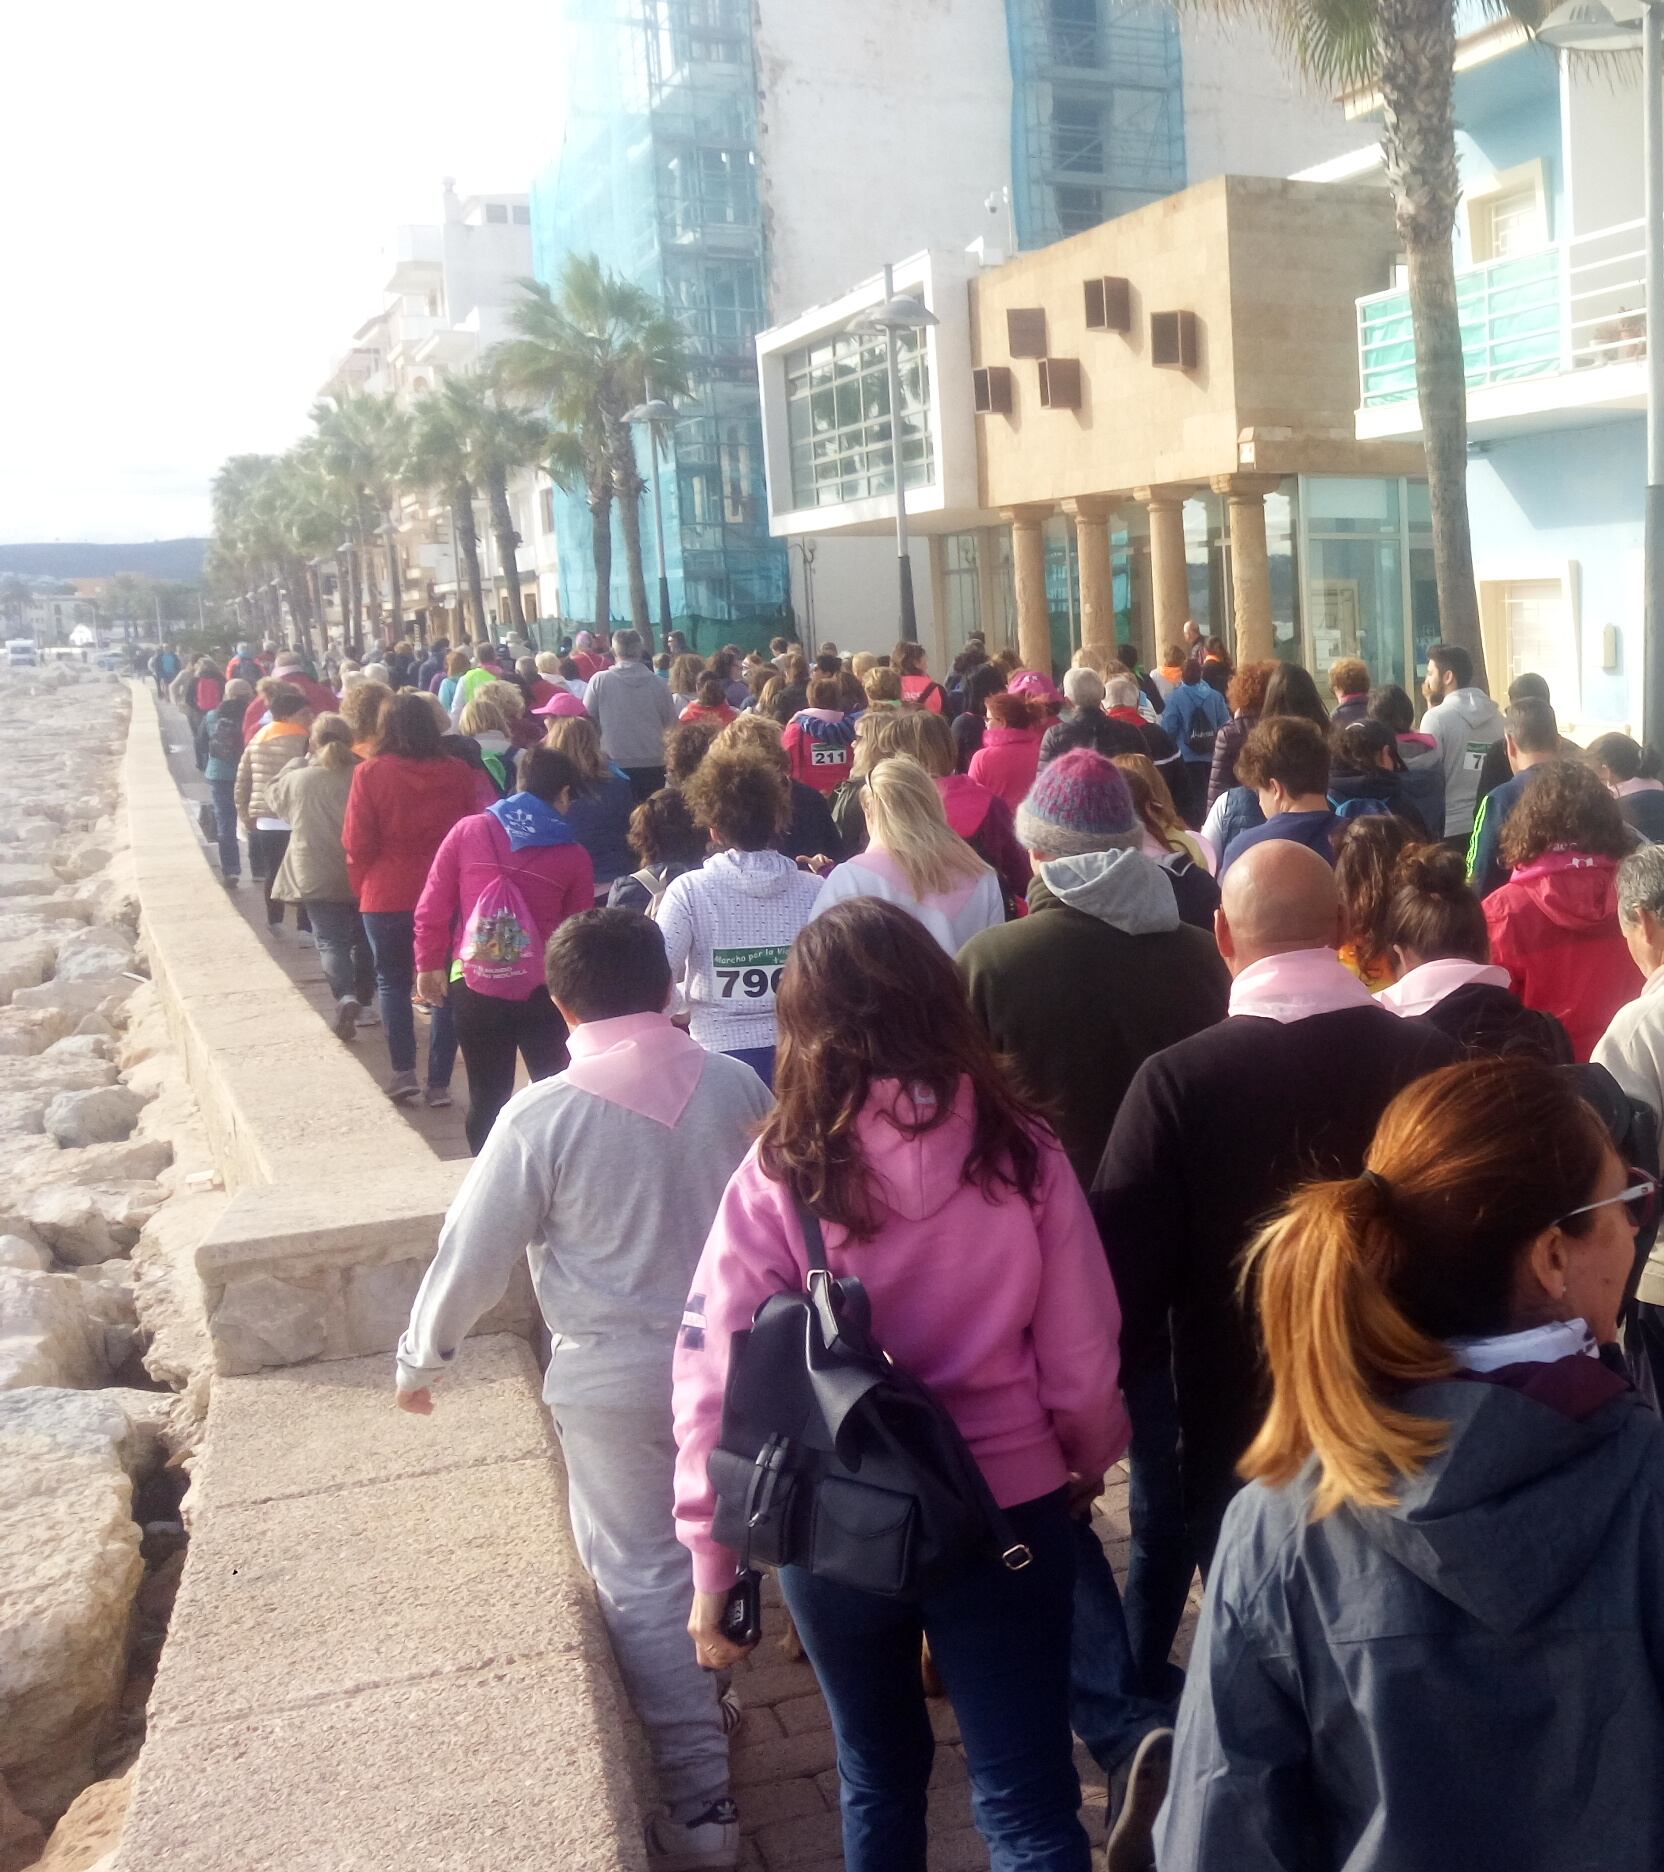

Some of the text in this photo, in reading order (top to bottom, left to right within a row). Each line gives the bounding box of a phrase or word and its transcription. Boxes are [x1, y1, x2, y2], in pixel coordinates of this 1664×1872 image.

[815, 752, 844, 764] 211
[715, 954, 746, 964] Marcha
[748, 951, 764, 962] por
[765, 948, 774, 956] la
